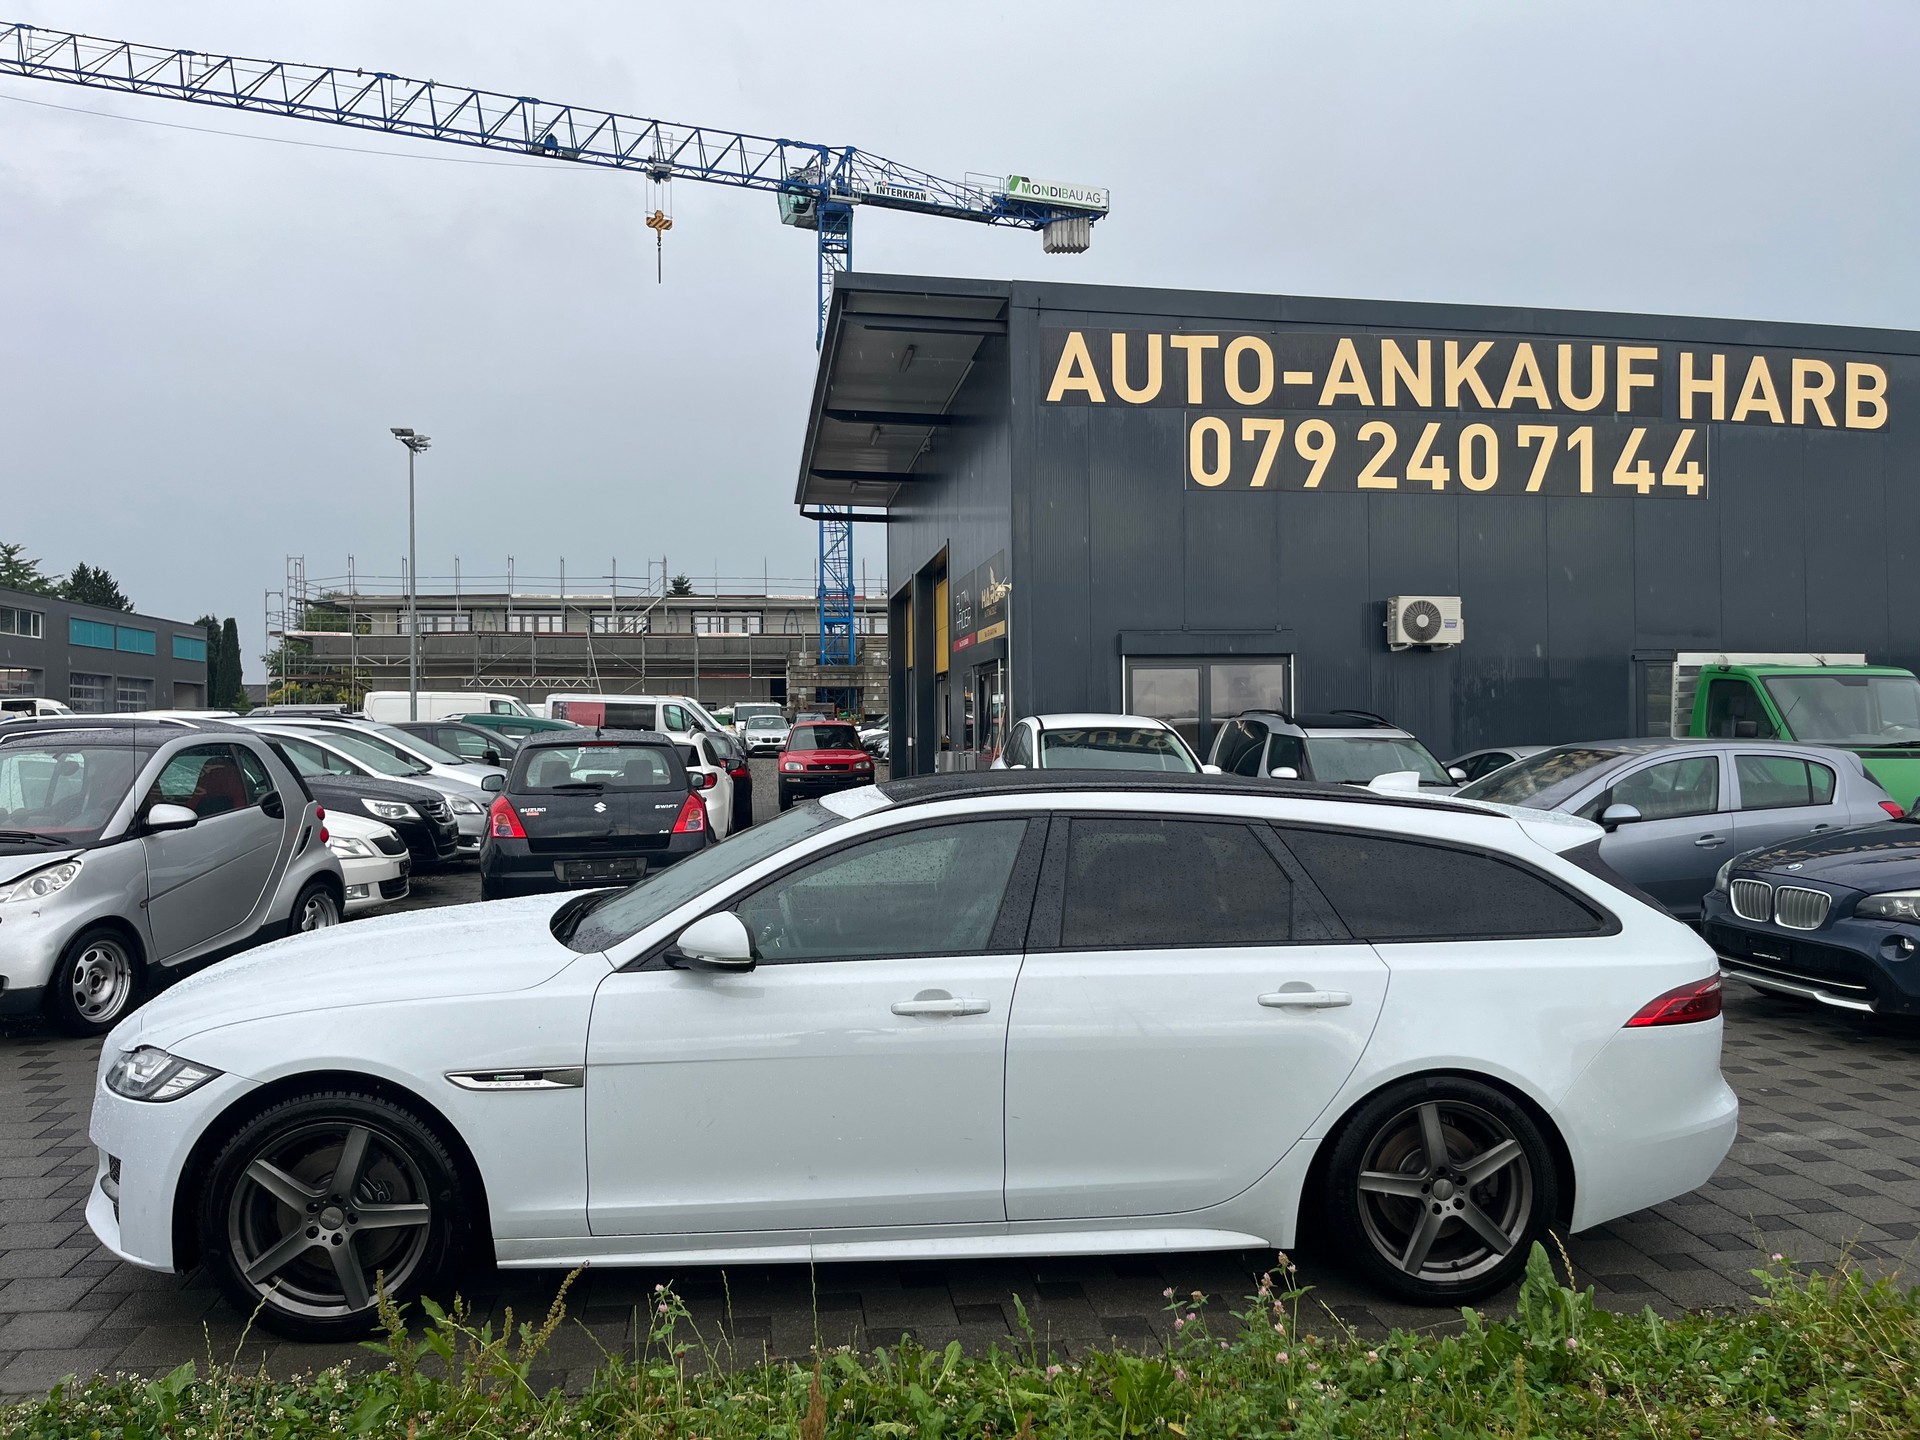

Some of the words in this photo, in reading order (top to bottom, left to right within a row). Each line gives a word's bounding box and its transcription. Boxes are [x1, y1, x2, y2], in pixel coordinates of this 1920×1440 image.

[876, 185, 927, 201] INTERKRAN
[1021, 182, 1084, 201] MONDIBAU
[1085, 192, 1101, 204] AG
[1047, 331, 1658, 412] AUTO-ANKAUF
[1679, 352, 1889, 429] HARB
[1190, 416, 1336, 488] 079
[1357, 421, 1499, 491] 240
[1517, 424, 1593, 493] 71
[1612, 427, 1705, 495] 44
